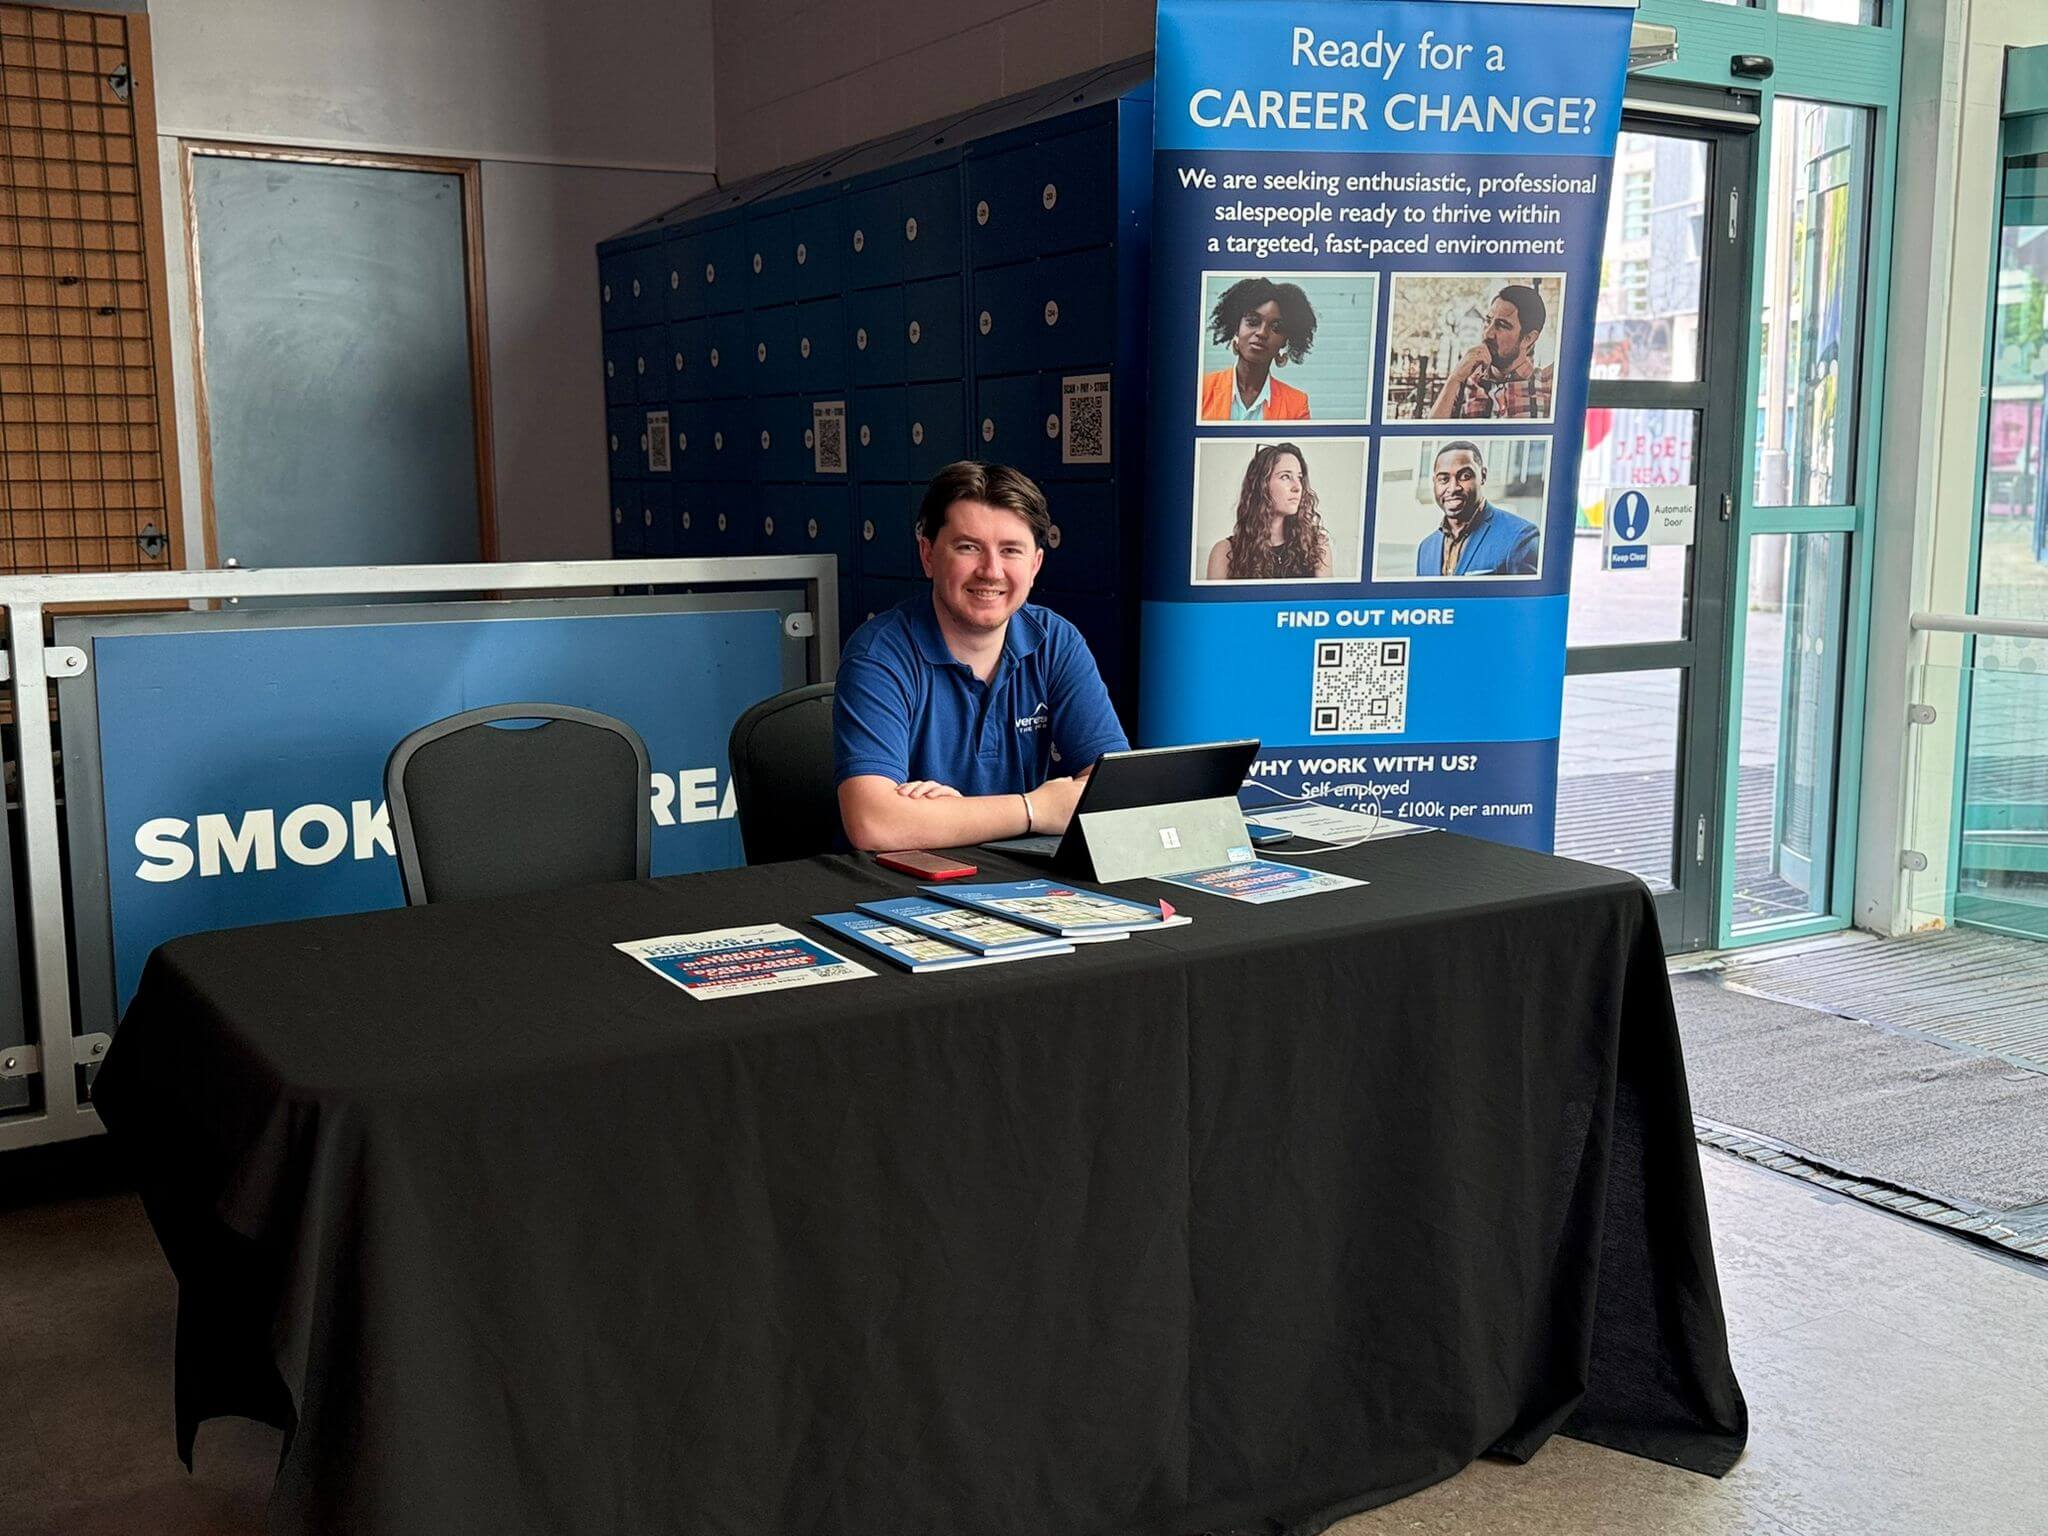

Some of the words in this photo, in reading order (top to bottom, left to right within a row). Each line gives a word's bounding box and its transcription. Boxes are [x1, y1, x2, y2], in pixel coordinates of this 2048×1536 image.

[1292, 26, 1406, 81] Ready
[1418, 30, 1474, 70] for
[1485, 44, 1506, 72] a
[1189, 88, 1369, 130] CAREER
[1383, 93, 1598, 135] CHANGE?
[1178, 167, 1217, 190] We
[1223, 173, 1257, 190] are
[1263, 169, 1341, 197] seeking
[1346, 171, 1472, 196] enthusiastic,
[1478, 172, 1598, 198] professional
[1214, 200, 1333, 229] salespeople
[1339, 202, 1398, 229] ready
[1403, 205, 1427, 223] to
[1432, 203, 1492, 224] thrive
[1498, 203, 1562, 224] within
[1207, 237, 1220, 252] a
[1226, 232, 1319, 259] targeted,
[1325, 232, 1429, 259] fast-paced
[1435, 234, 1565, 255] environment
[1655, 504, 1693, 516] Automatic
[1664, 517, 1683, 527] Door
[1277, 610, 1328, 628] FIND
[1335, 609, 1386, 627] OUT
[1391, 608, 1456, 626] MORE
[1297, 758, 1367, 775] WORK
[1373, 755, 1435, 773] WITH
[1440, 755, 1478, 772] US?
[1398, 801, 1445, 818] £100k
[1449, 804, 1478, 822] per
[1481, 802, 1533, 817] annum
